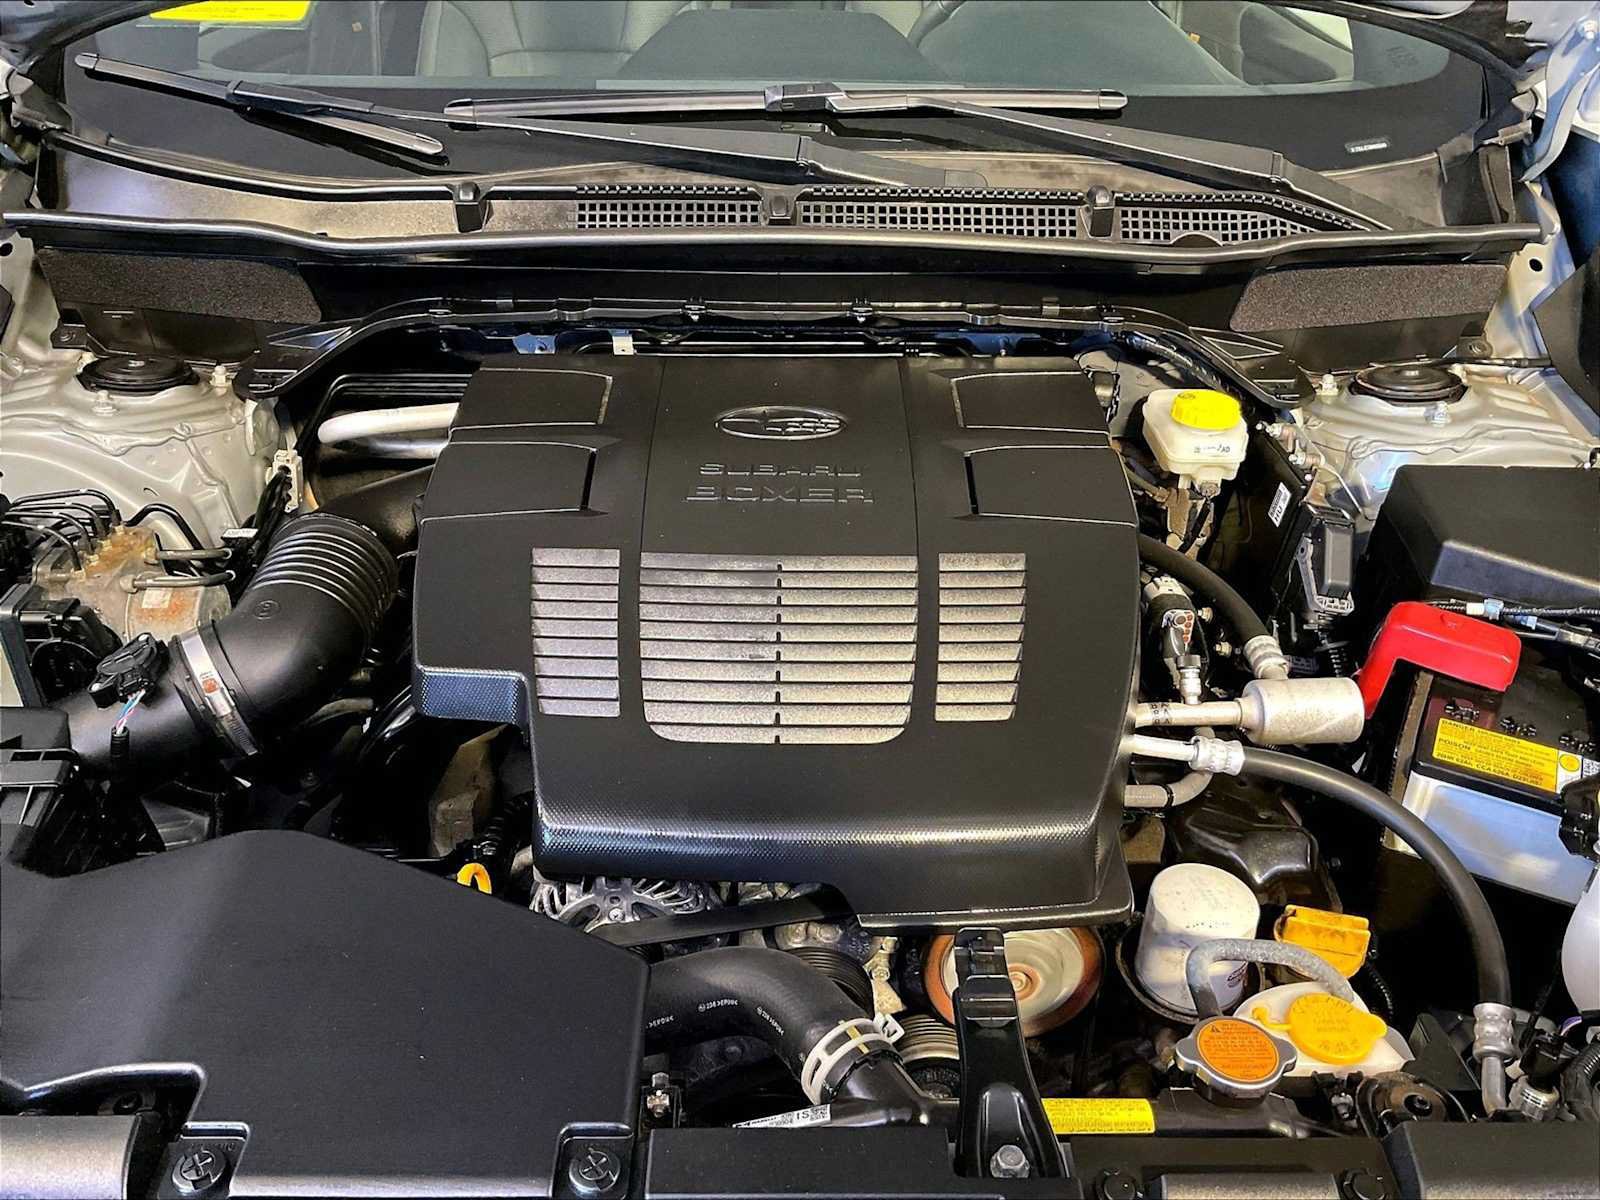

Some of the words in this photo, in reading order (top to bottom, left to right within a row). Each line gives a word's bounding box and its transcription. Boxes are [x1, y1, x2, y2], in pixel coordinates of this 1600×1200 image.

[700, 463, 861, 477] SUBARU
[686, 485, 874, 503] BOXER
[1438, 737, 1471, 750] POISON
